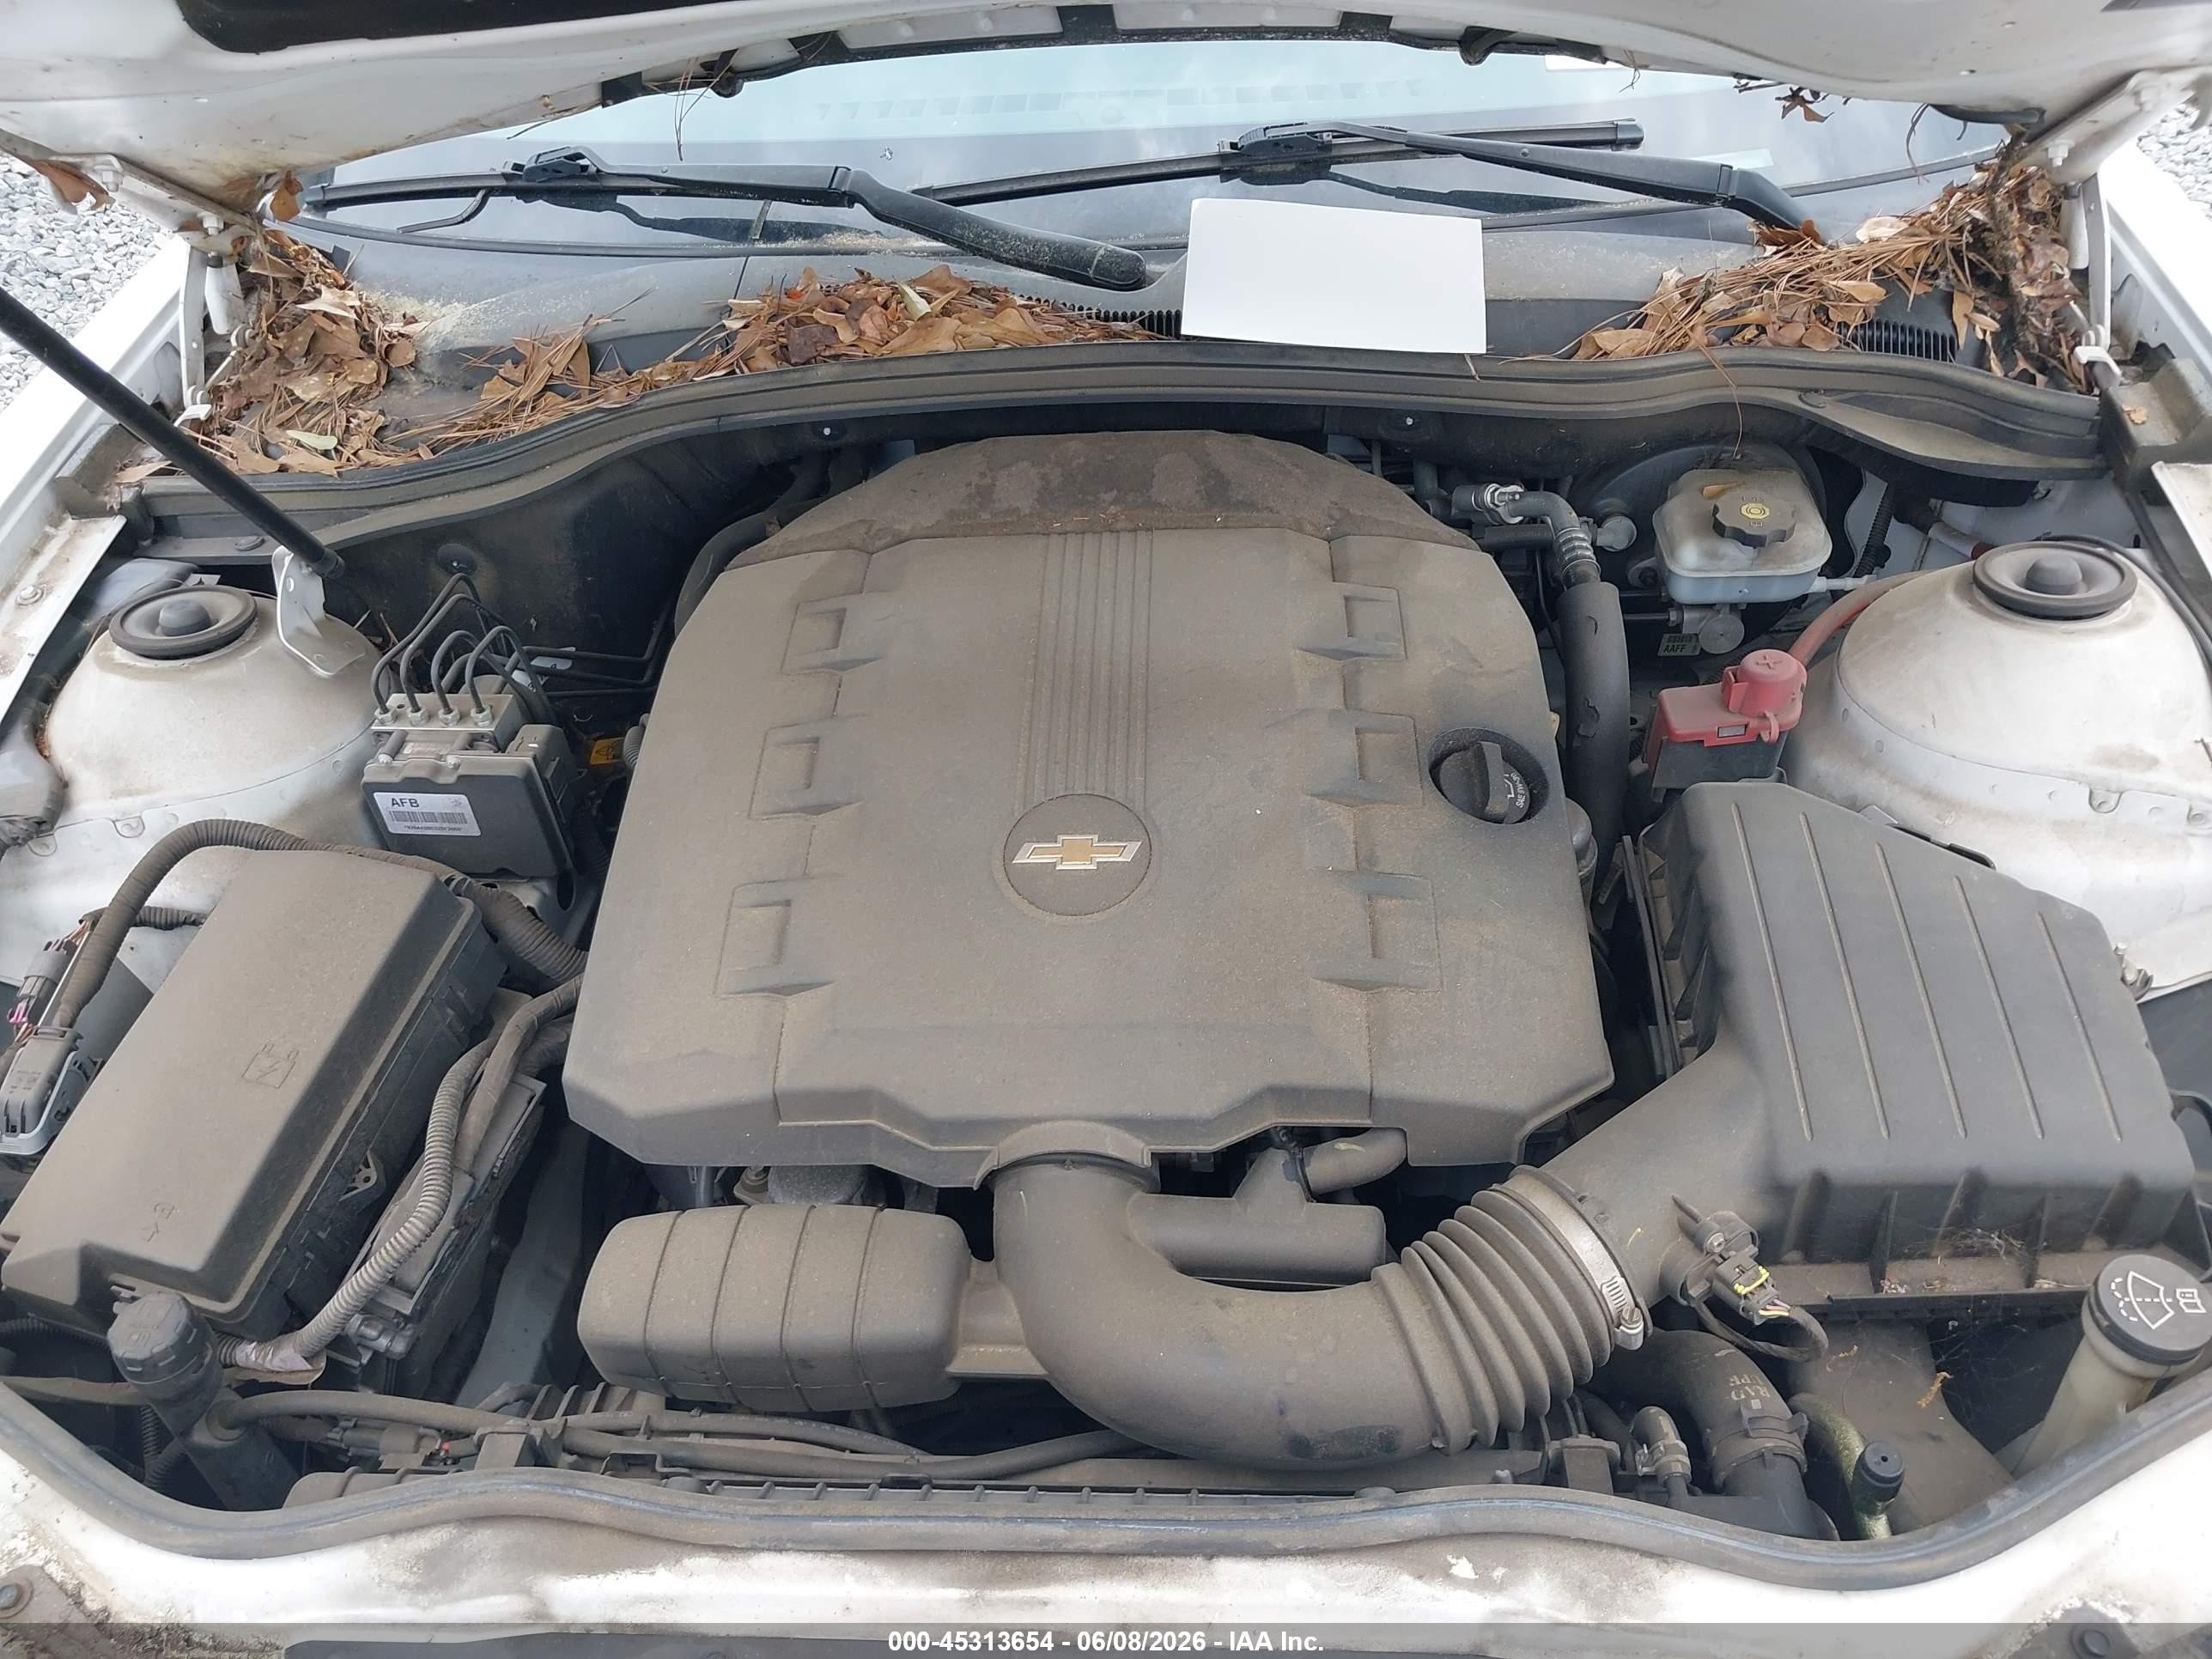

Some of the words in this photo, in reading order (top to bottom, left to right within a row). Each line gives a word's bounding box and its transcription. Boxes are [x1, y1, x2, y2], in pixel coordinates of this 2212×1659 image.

[1663, 644, 1686, 653] AAFF
[391, 797, 420, 808] AFB
[1516, 793, 1526, 808] SAE
